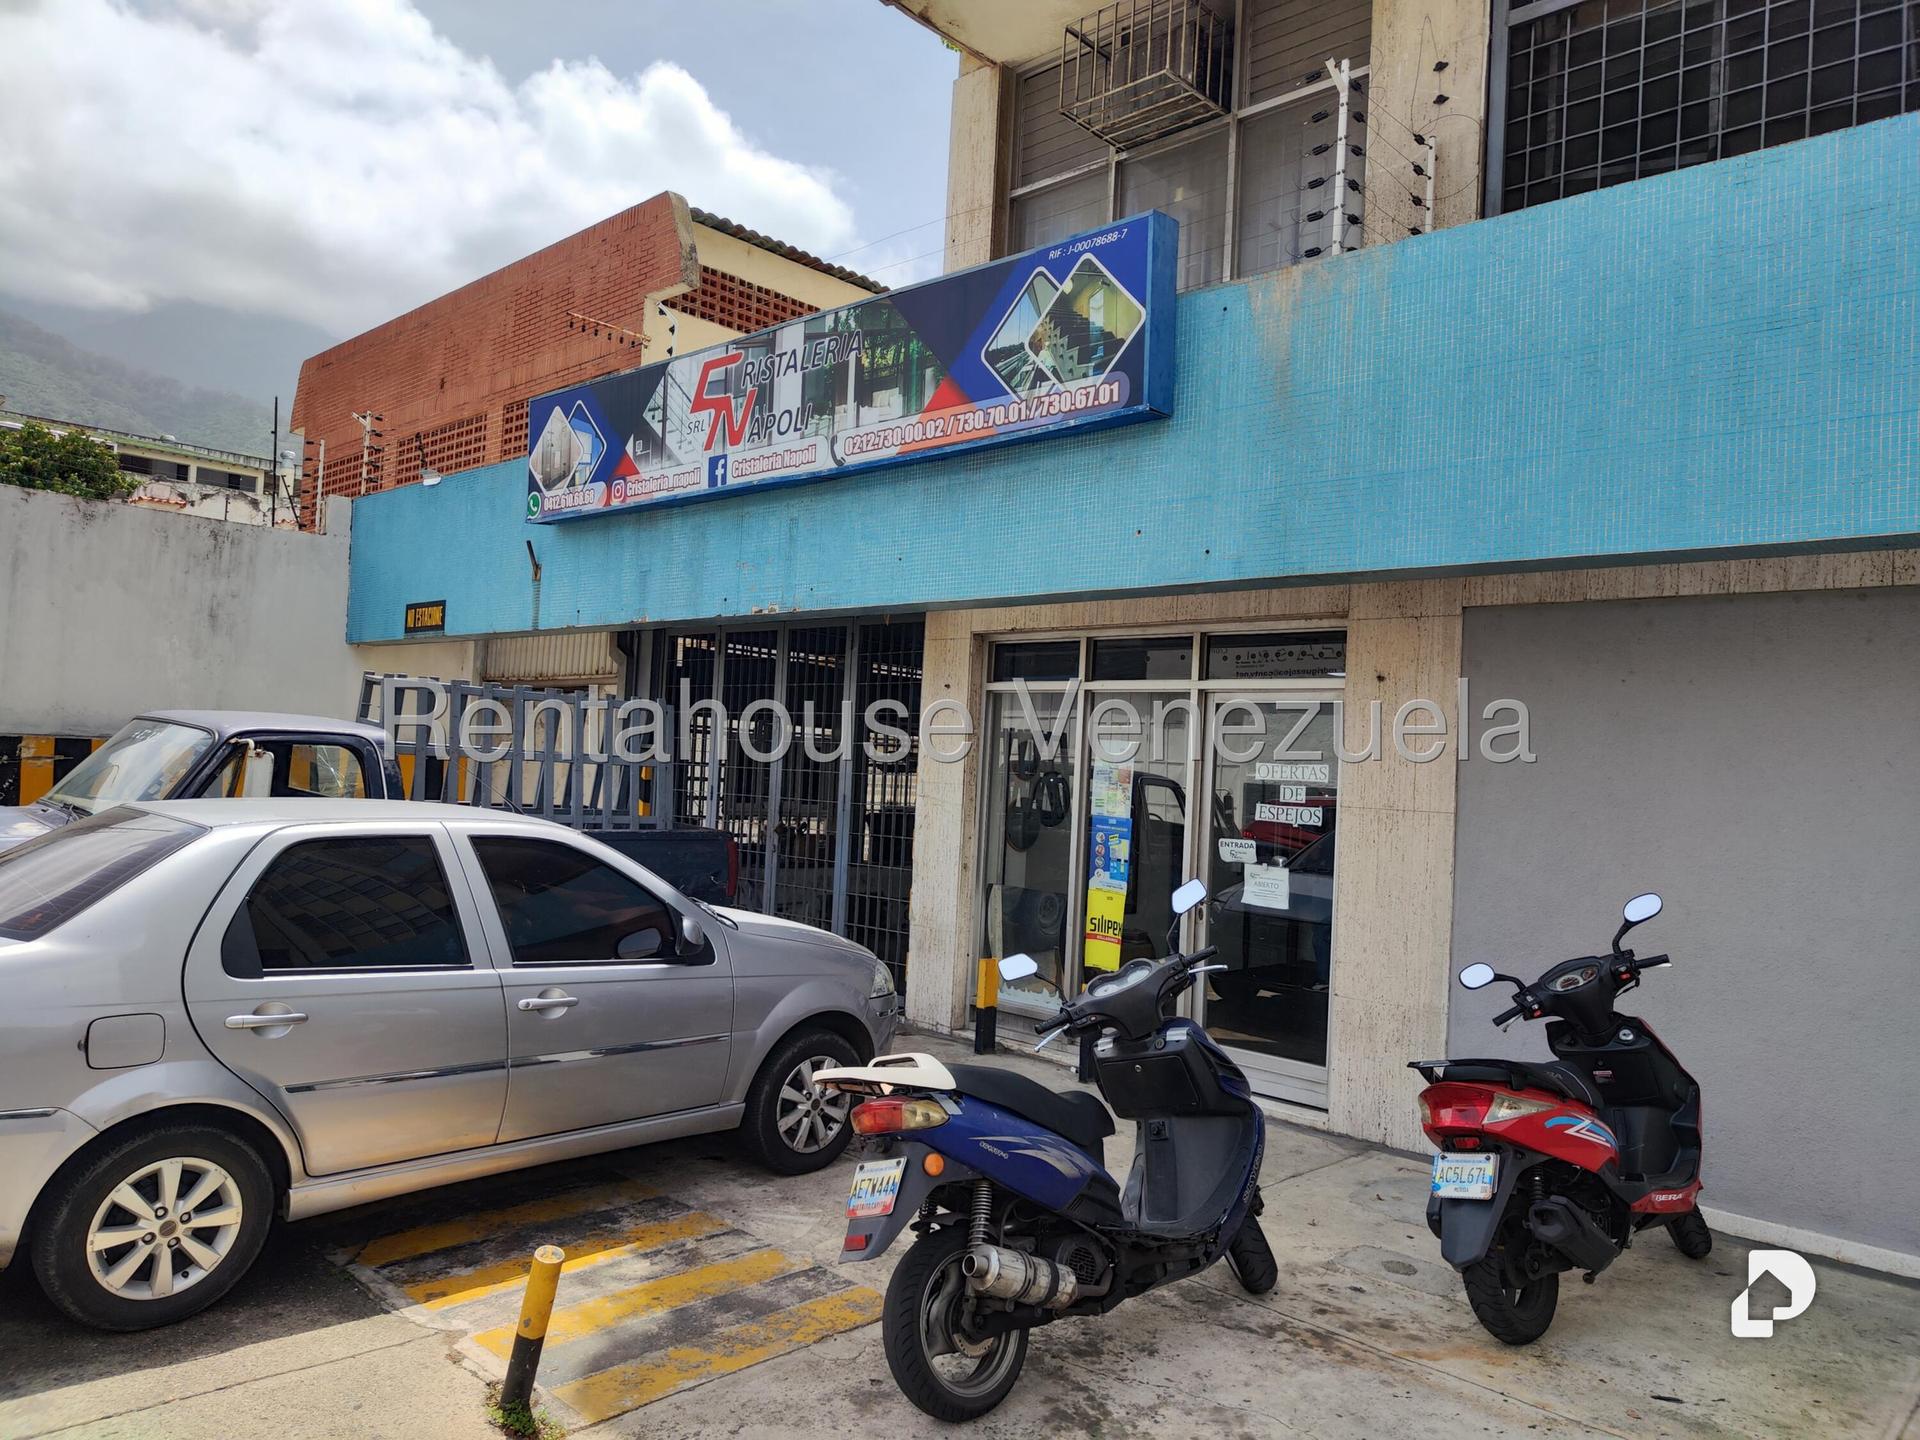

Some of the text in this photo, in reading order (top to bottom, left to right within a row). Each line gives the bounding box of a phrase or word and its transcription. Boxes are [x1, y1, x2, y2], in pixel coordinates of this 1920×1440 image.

[686, 418, 706, 436] SRL
[844, 418, 945, 456] 0212.730.00.02
[956, 401, 1027, 432] 730.70.01
[1041, 381, 1121, 416] 730.67.01
[732, 444, 817, 478] Cristaleria Napoli
[1257, 764, 1328, 781] OFERTAS
[1282, 786, 1304, 802] DE
[1258, 805, 1322, 825] ESPEJOS
[1219, 840, 1255, 850] ENTRADA
[1655, 1192, 1684, 1202] BERA
